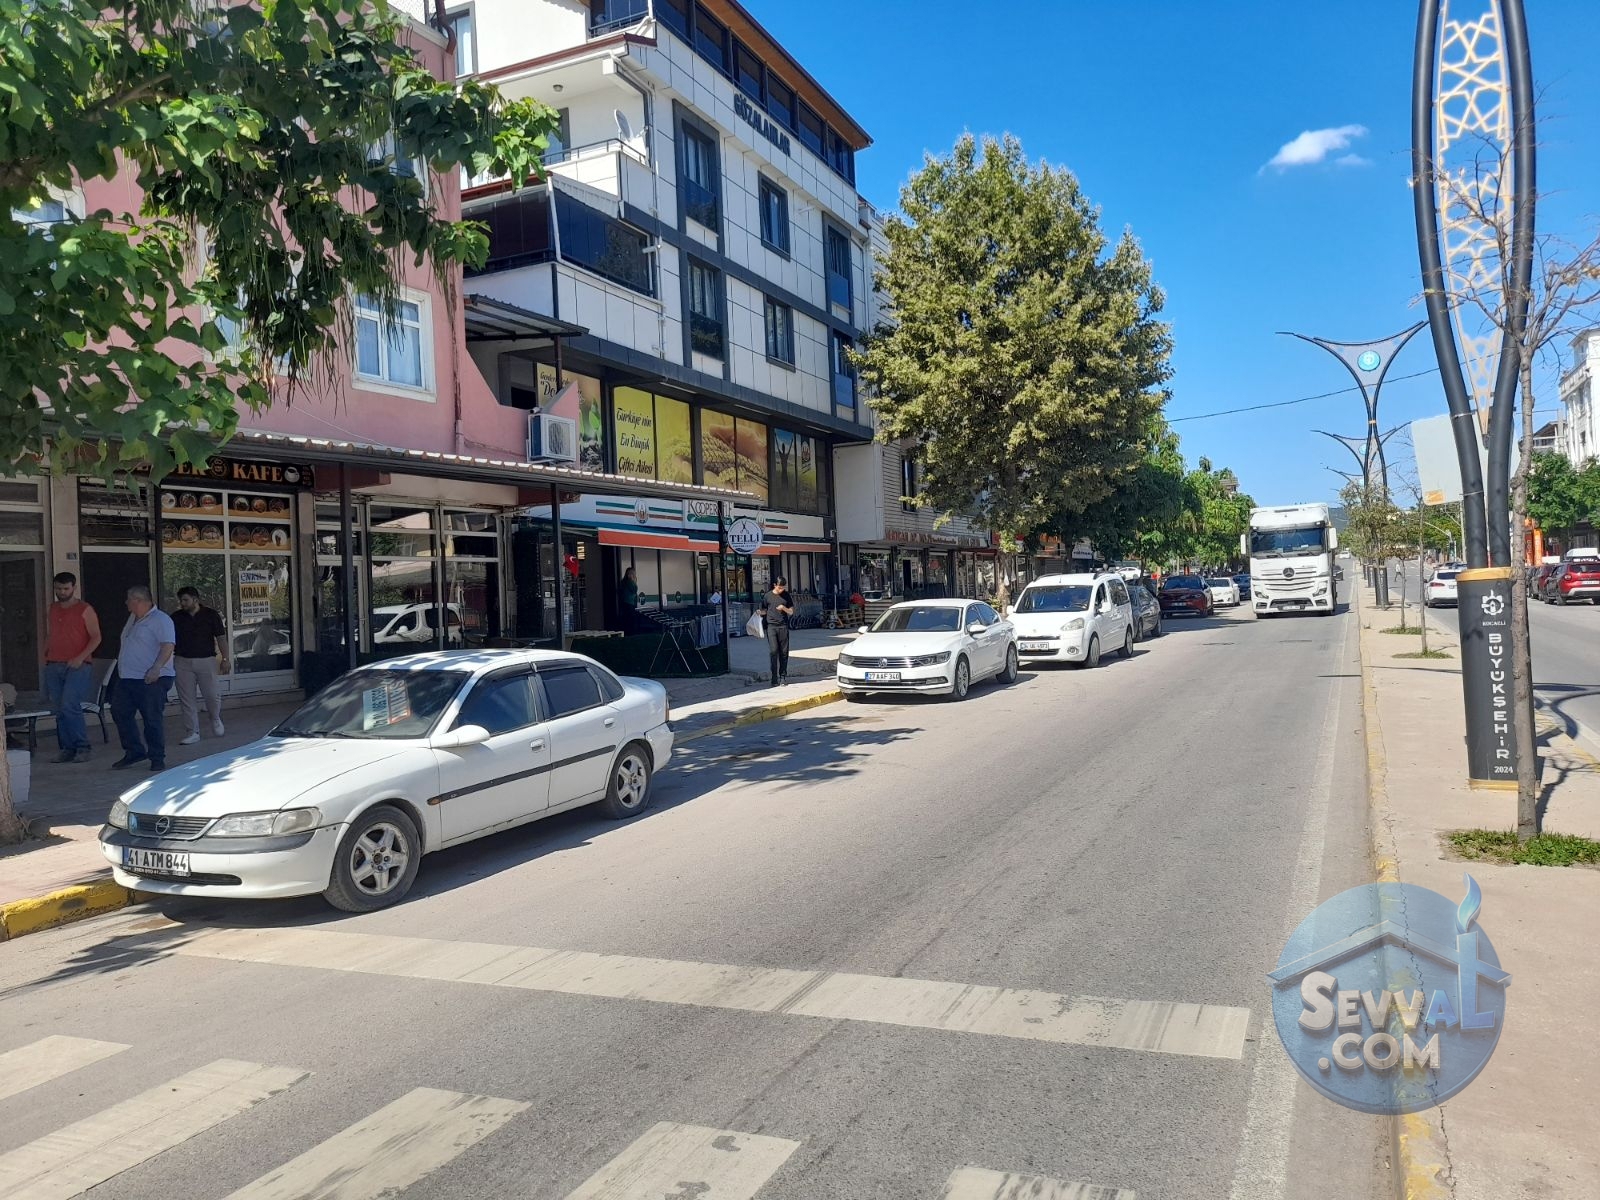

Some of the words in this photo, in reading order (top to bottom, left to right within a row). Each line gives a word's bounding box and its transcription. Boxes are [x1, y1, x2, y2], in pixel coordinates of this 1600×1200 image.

[233, 463, 283, 482] KAFE
[730, 533, 760, 543] TELLİ
[1488, 633, 1510, 759] BÜYÜKŞEHİR
[128, 849, 139, 865] 41
[143, 851, 164, 868] ATM
[166, 854, 186, 870] 844
